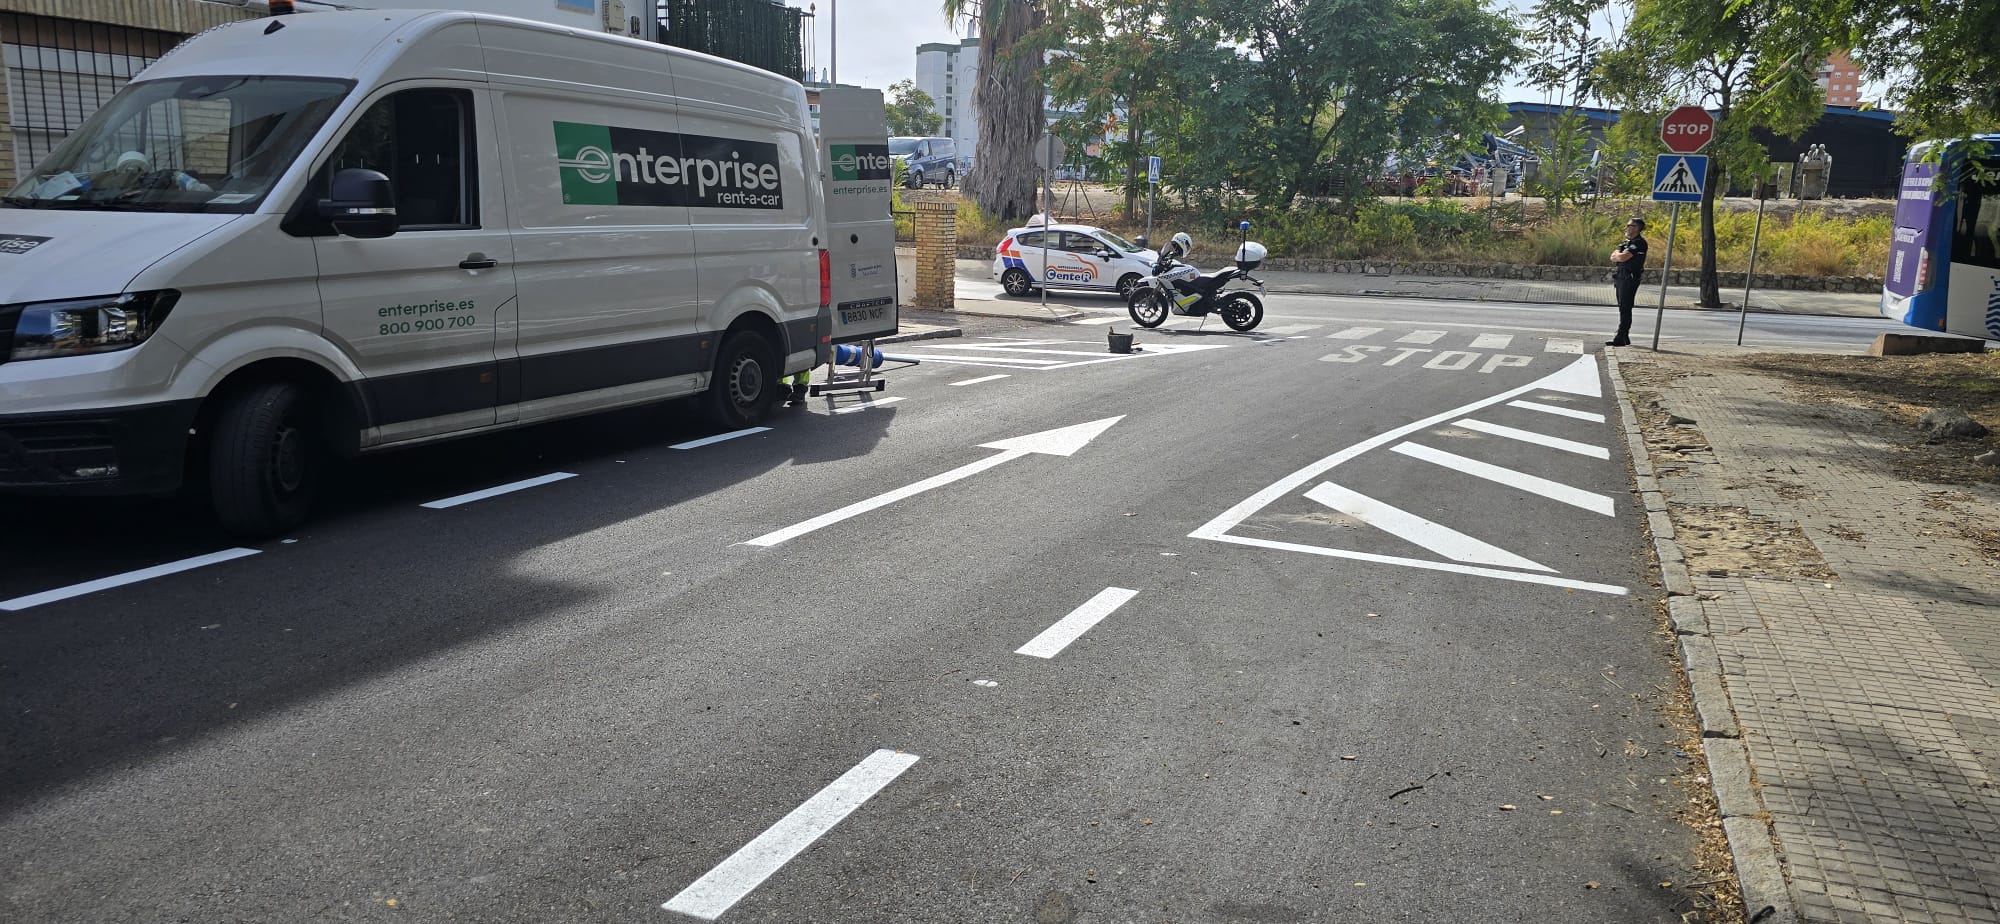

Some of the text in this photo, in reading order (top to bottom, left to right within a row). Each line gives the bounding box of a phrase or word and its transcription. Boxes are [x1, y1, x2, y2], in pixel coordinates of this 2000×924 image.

[1666, 123, 1709, 135] STOP
[559, 146, 779, 198] enterprise
[717, 190, 780, 206] rent-a-car
[833, 184, 888, 196] enterprise.es
[378, 299, 475, 317] enterprise.es
[379, 315, 475, 336] 800 900 700
[1317, 344, 1535, 374] STOP
